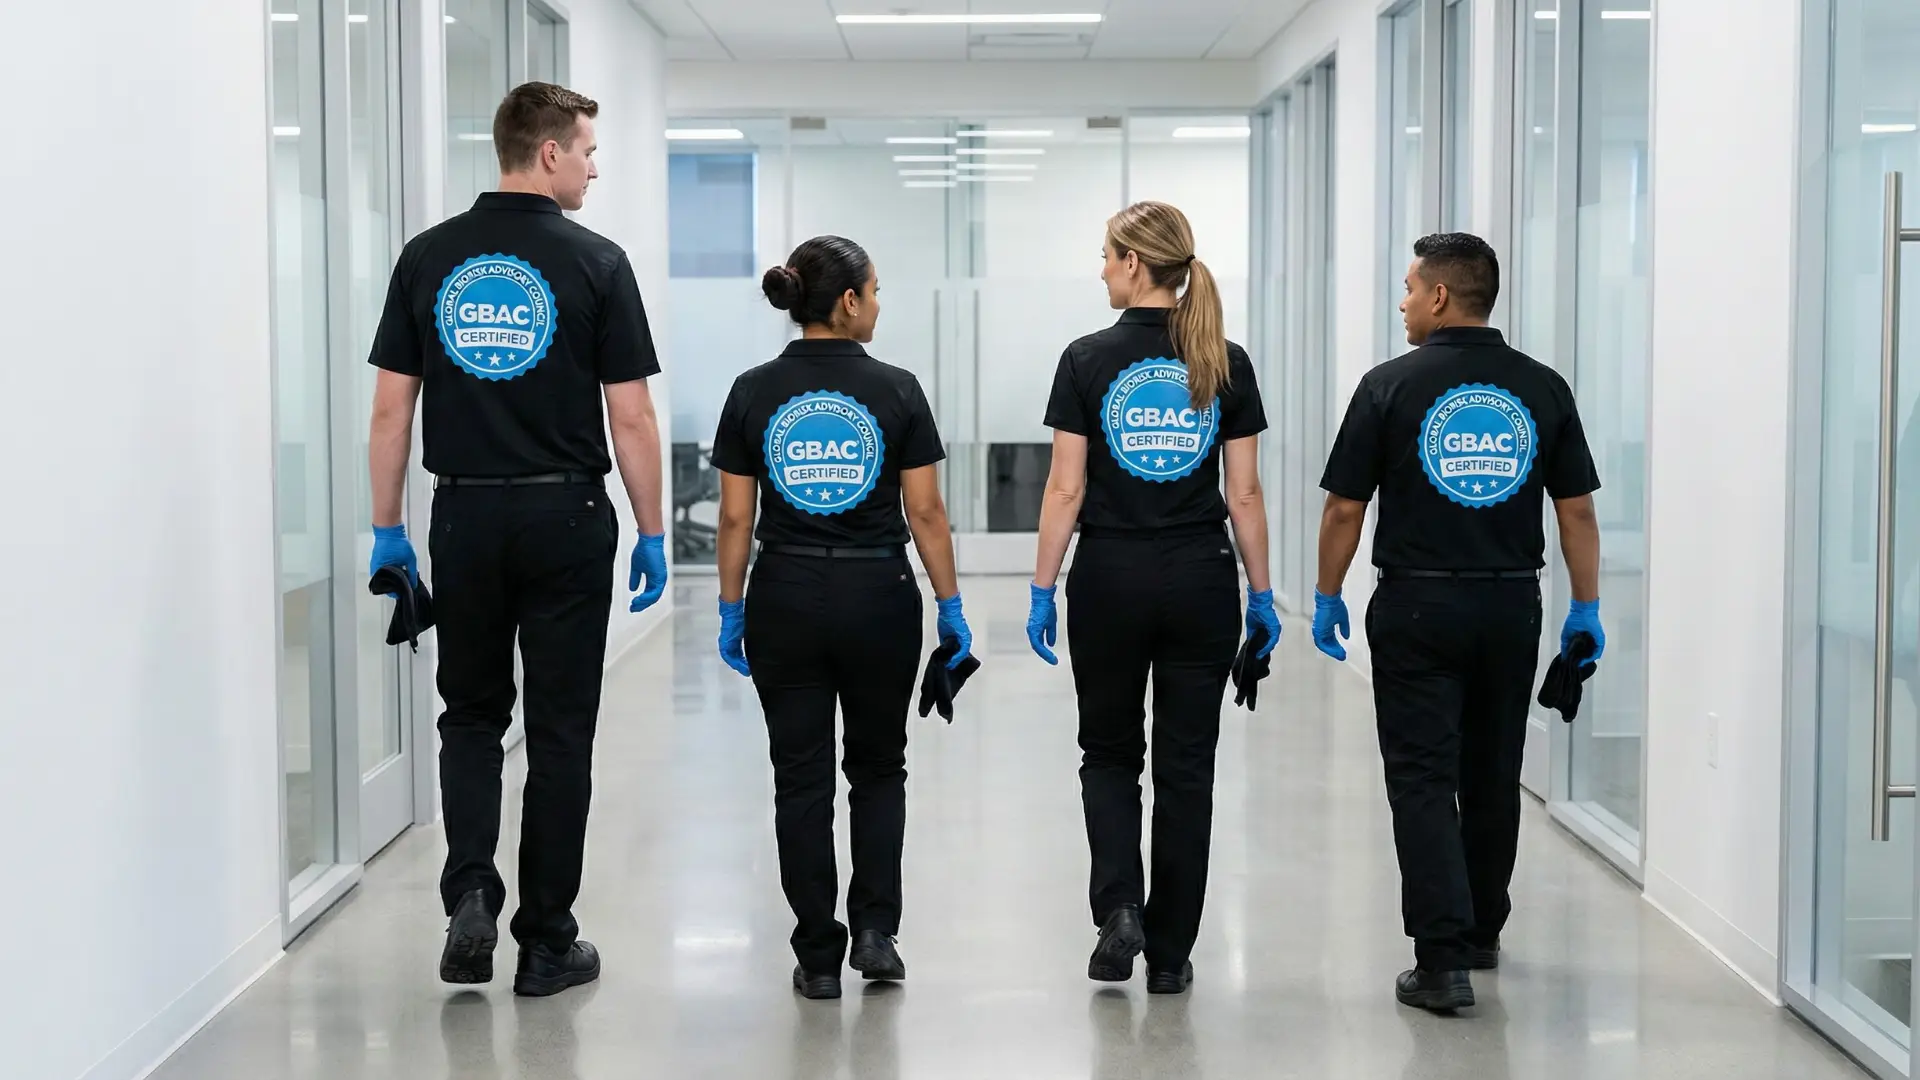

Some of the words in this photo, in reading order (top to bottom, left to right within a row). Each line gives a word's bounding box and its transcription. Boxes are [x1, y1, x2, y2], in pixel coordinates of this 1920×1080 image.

[488, 264, 533, 287] ADVISORY
[529, 285, 546, 327] COUNCIL
[459, 302, 530, 326] GBAC
[460, 331, 530, 346] CERTIFIED
[1153, 369, 1189, 387] ADVISO
[1201, 407, 1211, 430] NCIL
[1125, 407, 1197, 429] GBAC
[1468, 394, 1513, 414] ADVISORY
[1510, 412, 1528, 453] COUNCIL
[772, 427, 786, 464] GLOBAL
[856, 420, 875, 461] COUNCIL
[786, 440, 859, 461] GBAC
[1126, 434, 1196, 449] CERTIFIED
[1443, 433, 1513, 453] GBAC
[789, 467, 859, 481] CERTIFIED
[1445, 460, 1513, 473] CERTIFIED
